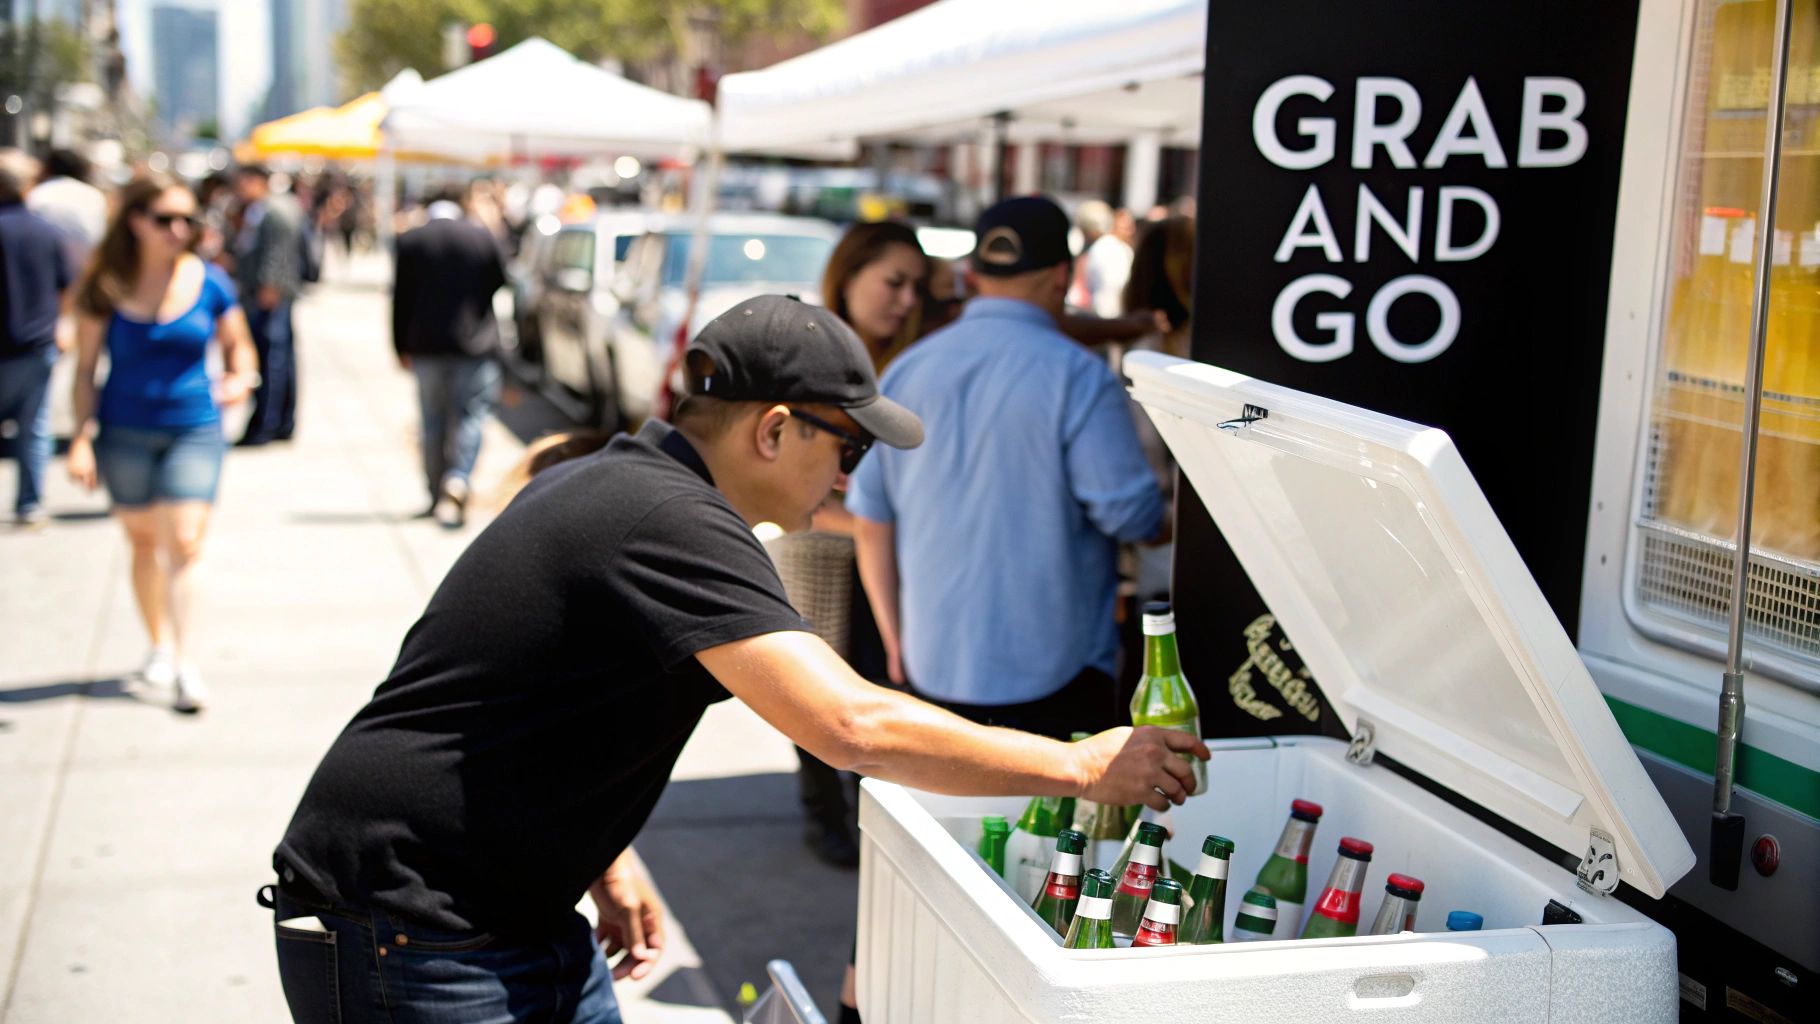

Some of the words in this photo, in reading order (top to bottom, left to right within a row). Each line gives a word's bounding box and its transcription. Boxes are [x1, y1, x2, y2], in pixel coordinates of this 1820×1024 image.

[1252, 75, 1589, 170] GRAB
[1274, 183, 1500, 263] AND
[1271, 274, 1461, 363] GO
